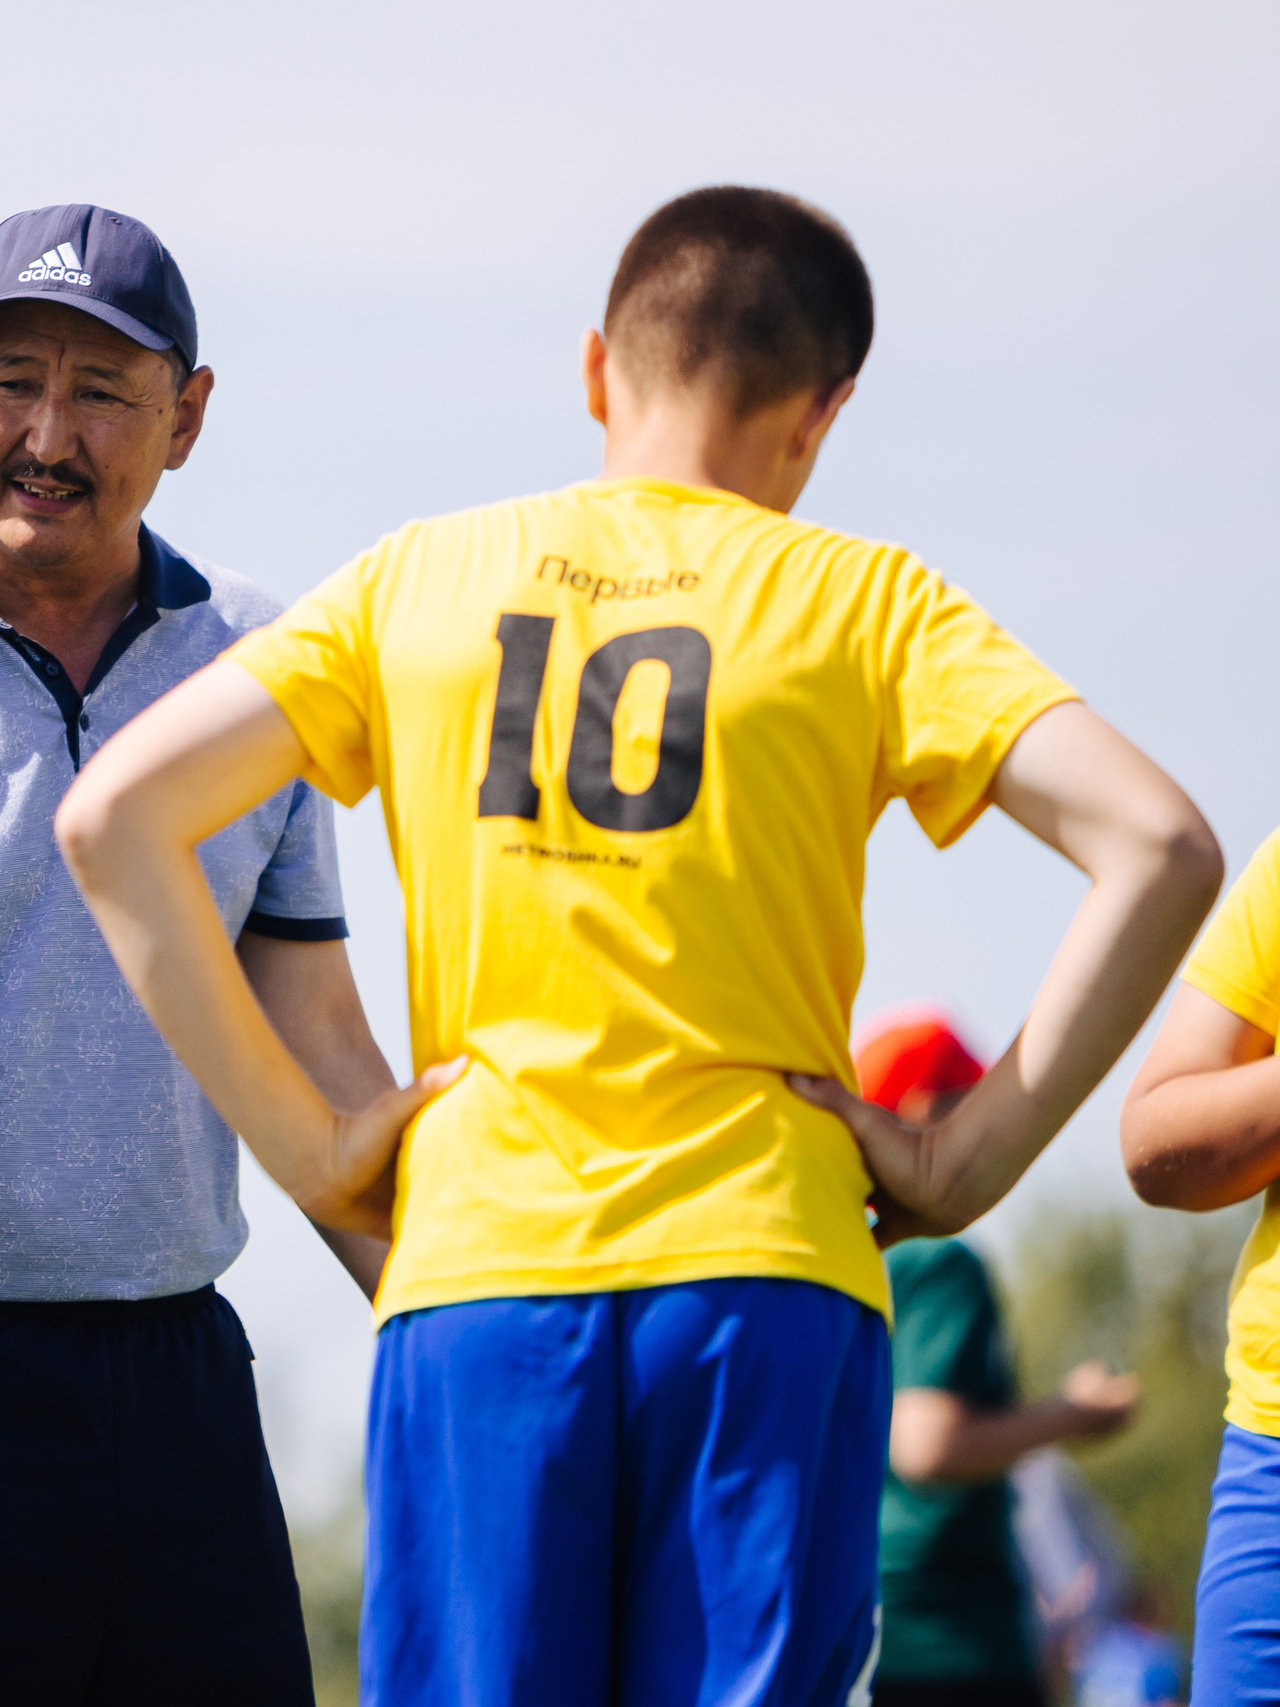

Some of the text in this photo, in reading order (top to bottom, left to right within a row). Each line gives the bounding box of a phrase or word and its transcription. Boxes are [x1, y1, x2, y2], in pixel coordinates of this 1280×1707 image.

[18, 265, 92, 286] adidas
[537, 556, 700, 604] Первые
[477, 612, 713, 833] 10
